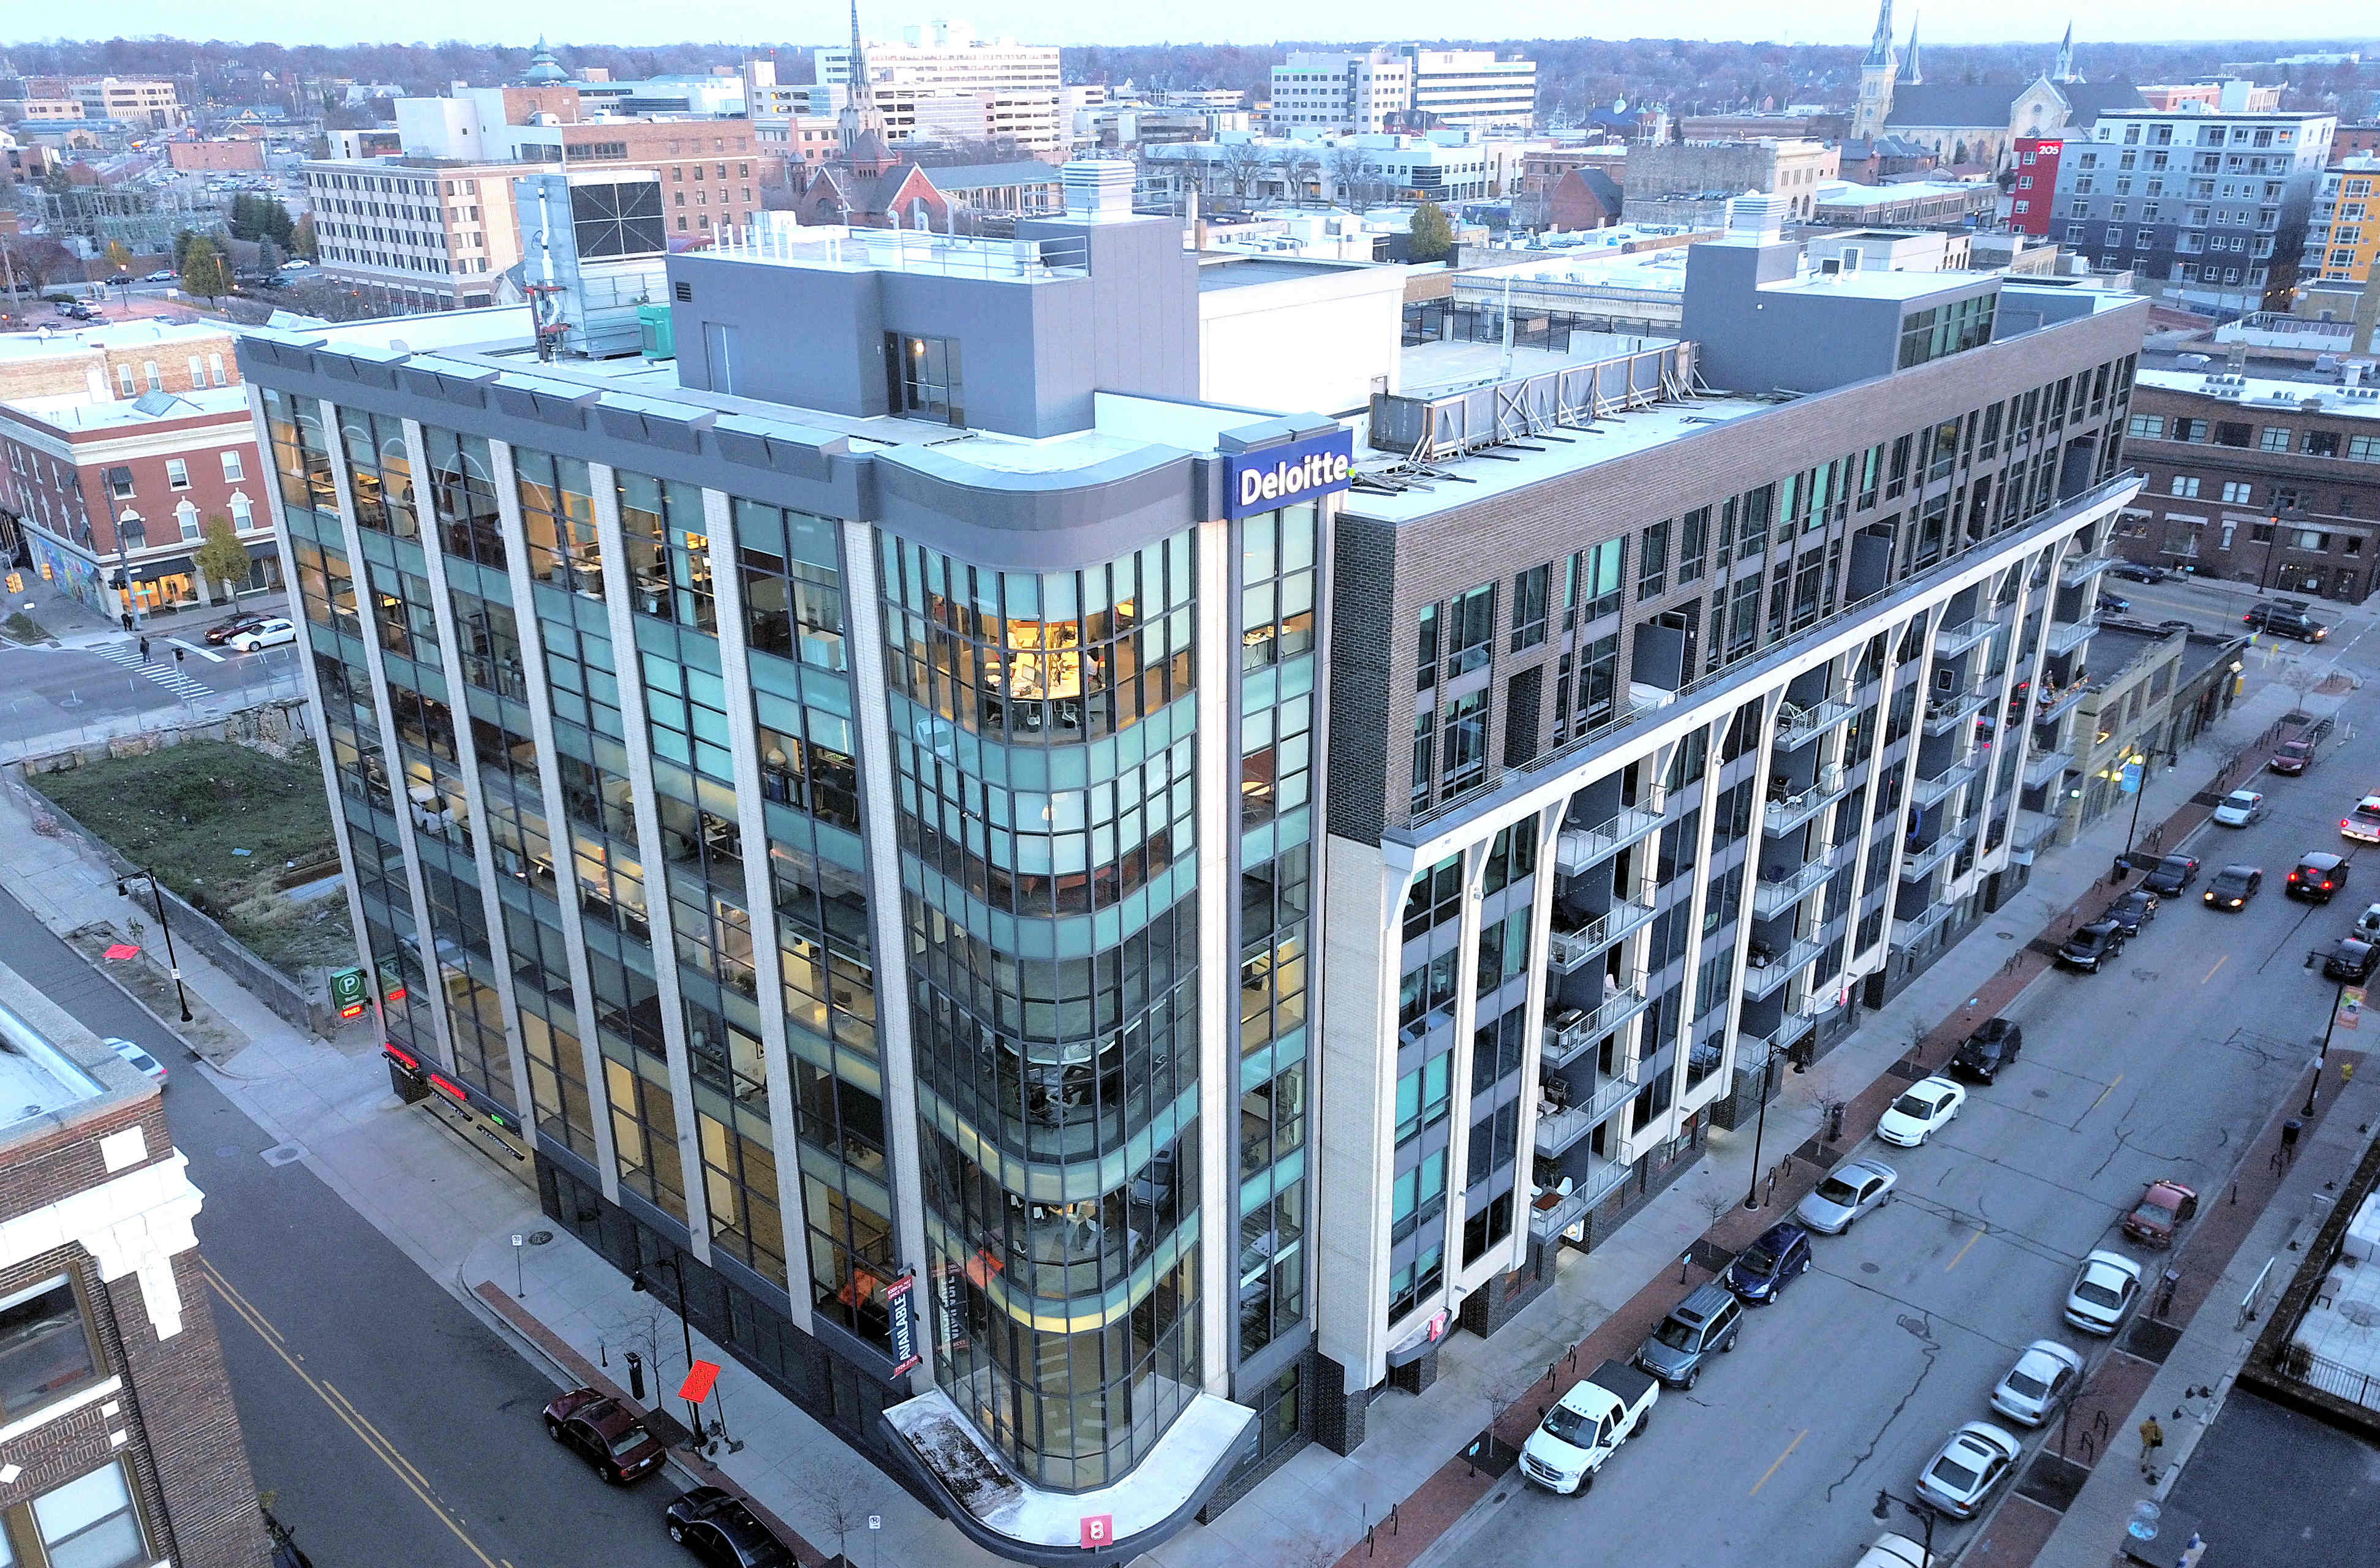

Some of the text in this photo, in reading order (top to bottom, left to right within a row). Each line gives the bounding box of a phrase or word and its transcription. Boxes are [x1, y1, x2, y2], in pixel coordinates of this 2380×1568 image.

[2039, 145, 2059, 154] 205
[344, 977, 355, 992] P
[894, 1293, 911, 1361] AVAILABLE
[690, 1365, 707, 1379] ROAD
[687, 1371, 711, 1390] CLOSED
[691, 1378, 711, 1396] AHEAD
